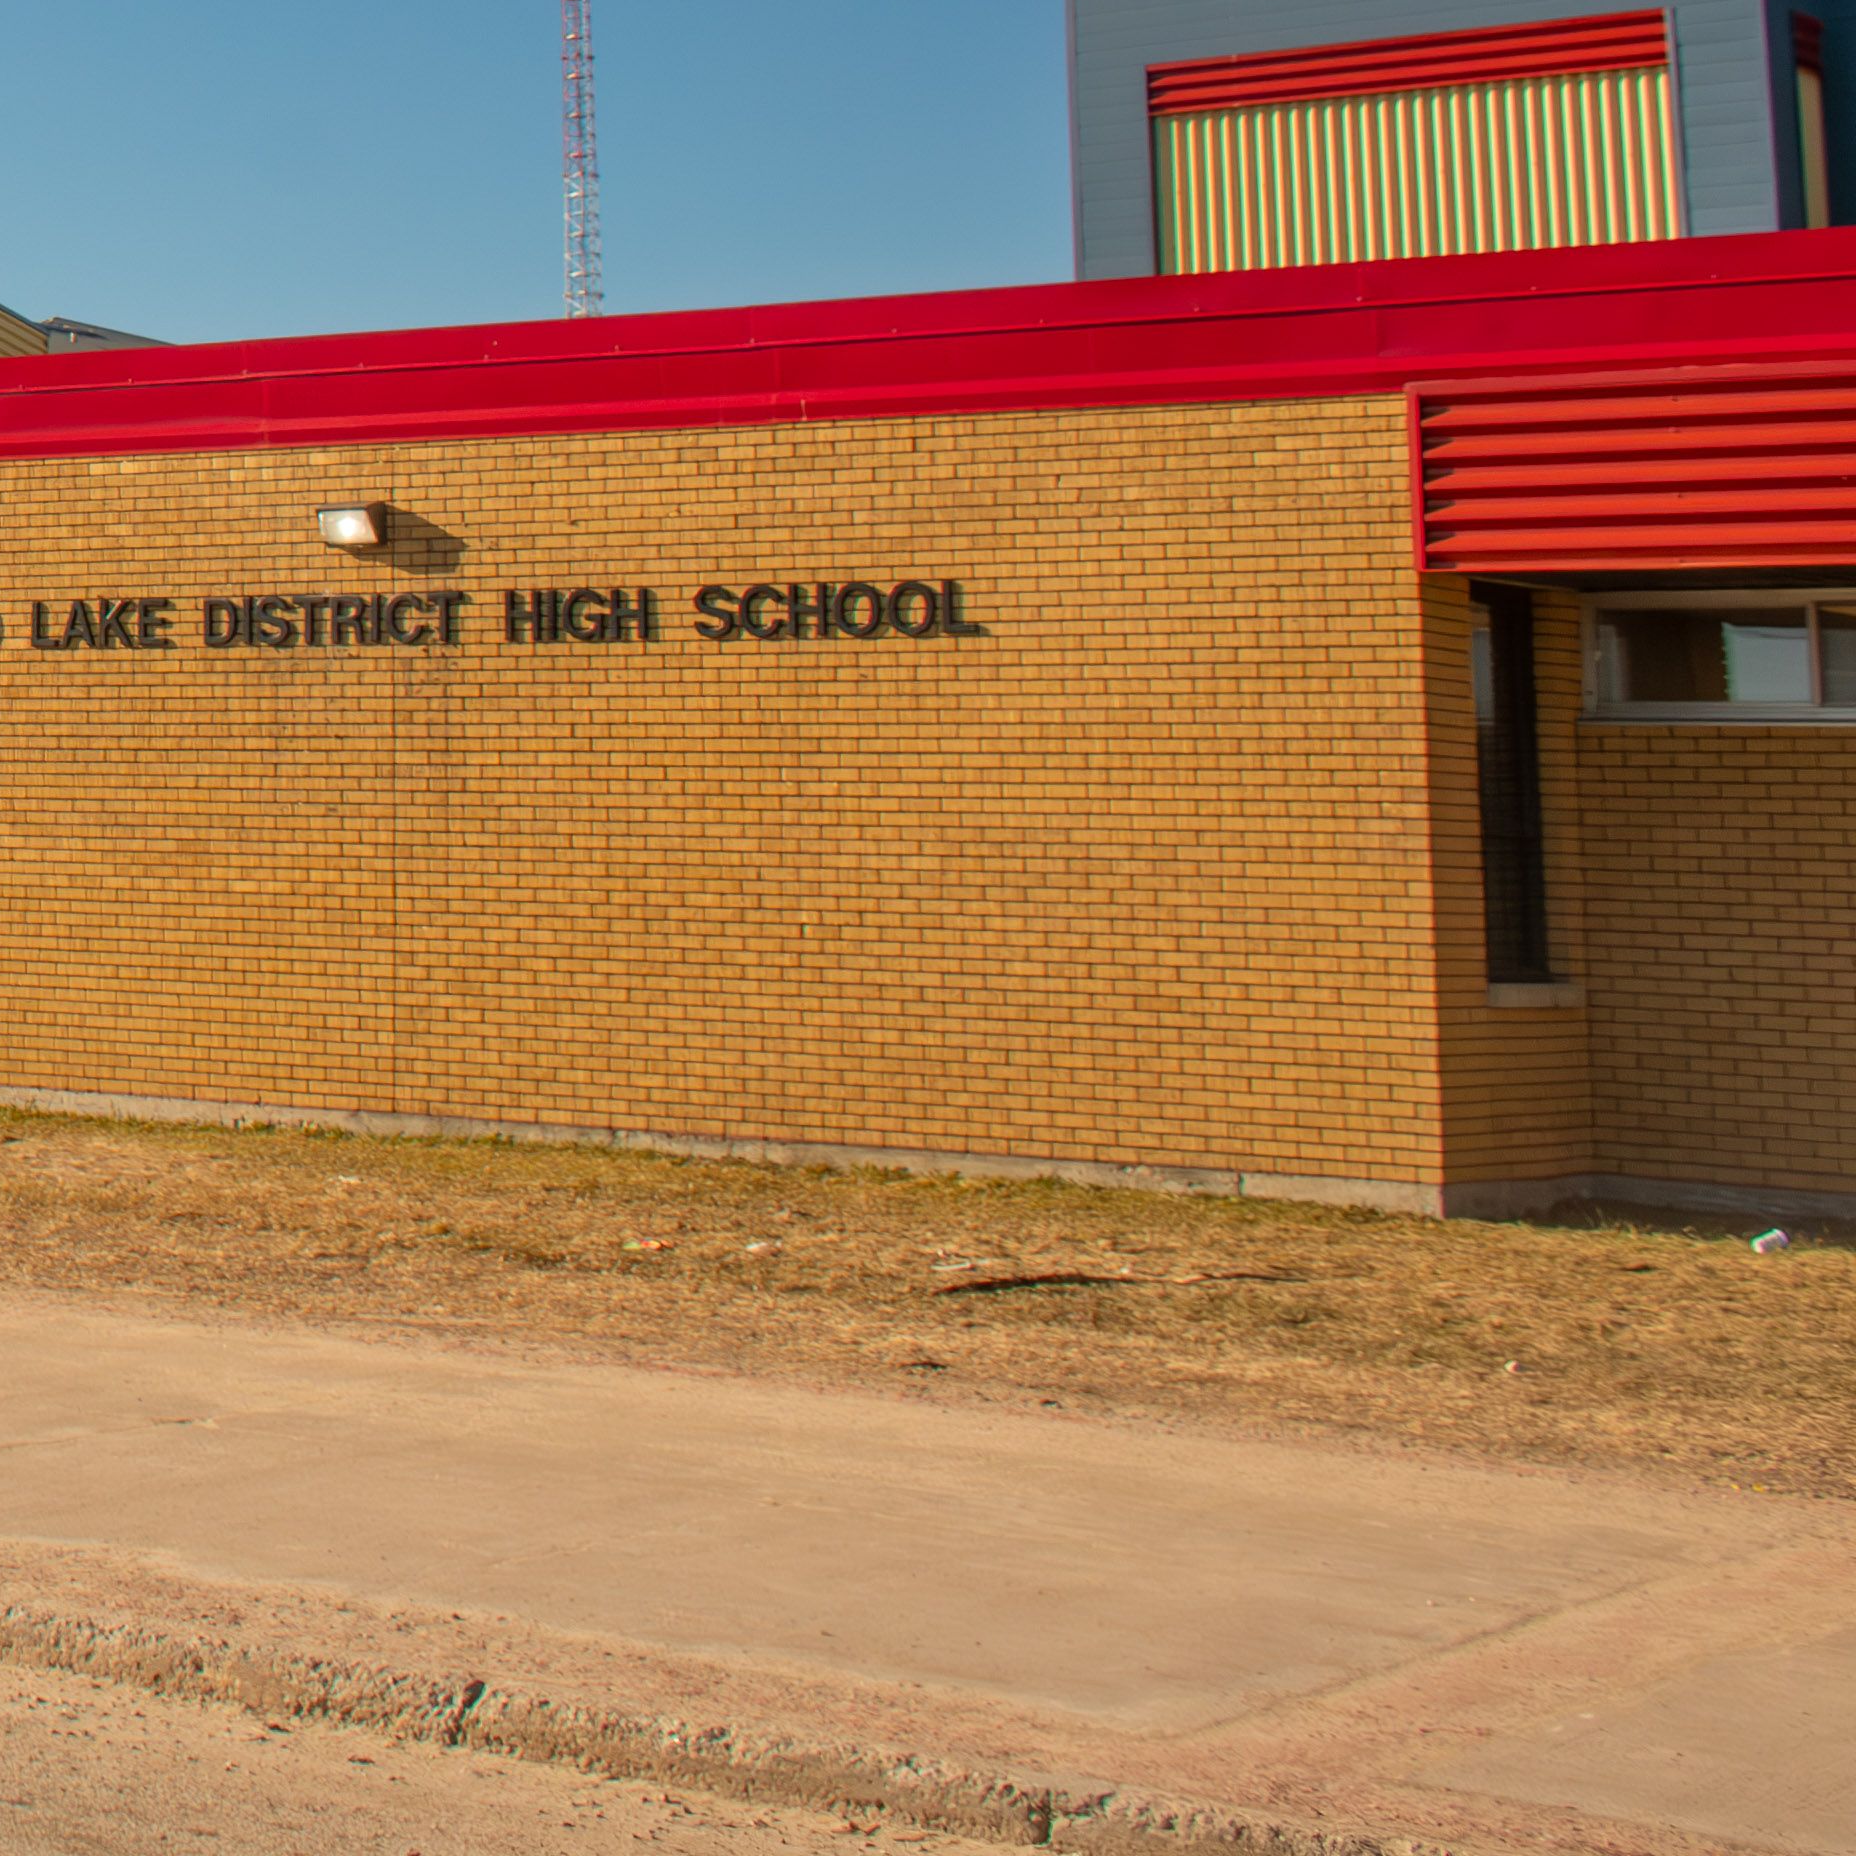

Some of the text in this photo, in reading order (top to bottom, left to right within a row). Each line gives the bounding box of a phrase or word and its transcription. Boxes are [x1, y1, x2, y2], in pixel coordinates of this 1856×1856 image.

[31, 597, 169, 648] LAKE
[204, 590, 463, 646] DISTRICT
[505, 587, 649, 641] HIGH
[694, 580, 981, 639] SCHOOL
